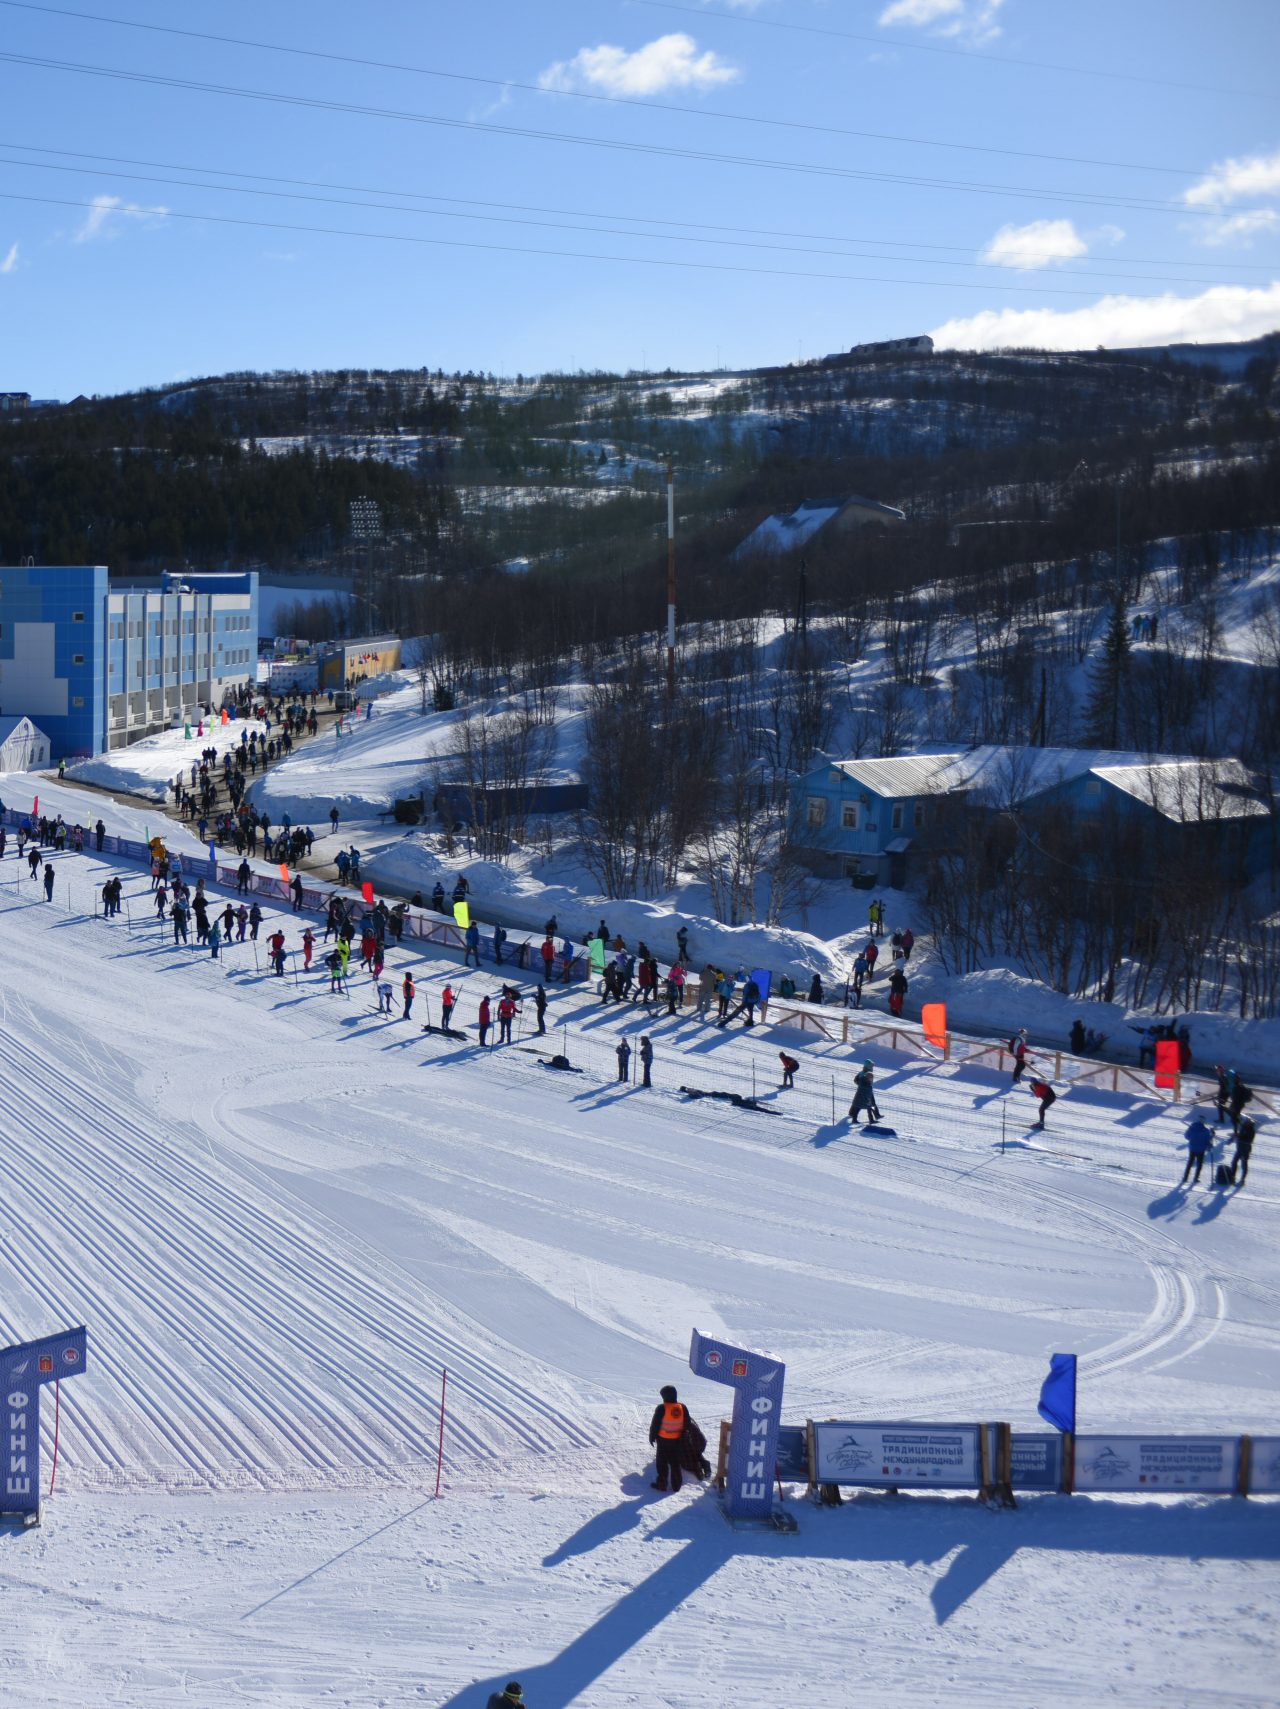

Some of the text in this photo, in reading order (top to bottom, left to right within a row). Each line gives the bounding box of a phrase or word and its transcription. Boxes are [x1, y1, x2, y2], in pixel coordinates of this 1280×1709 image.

[6, 1391, 30, 1494] ФИНИШ
[741, 1396, 773, 1499] ФИНИШ
[882, 1445, 963, 1456] ТРАДИЦИОННЫЙ
[883, 1455, 963, 1465] МЕЖДУНАРОДНЫЙ
